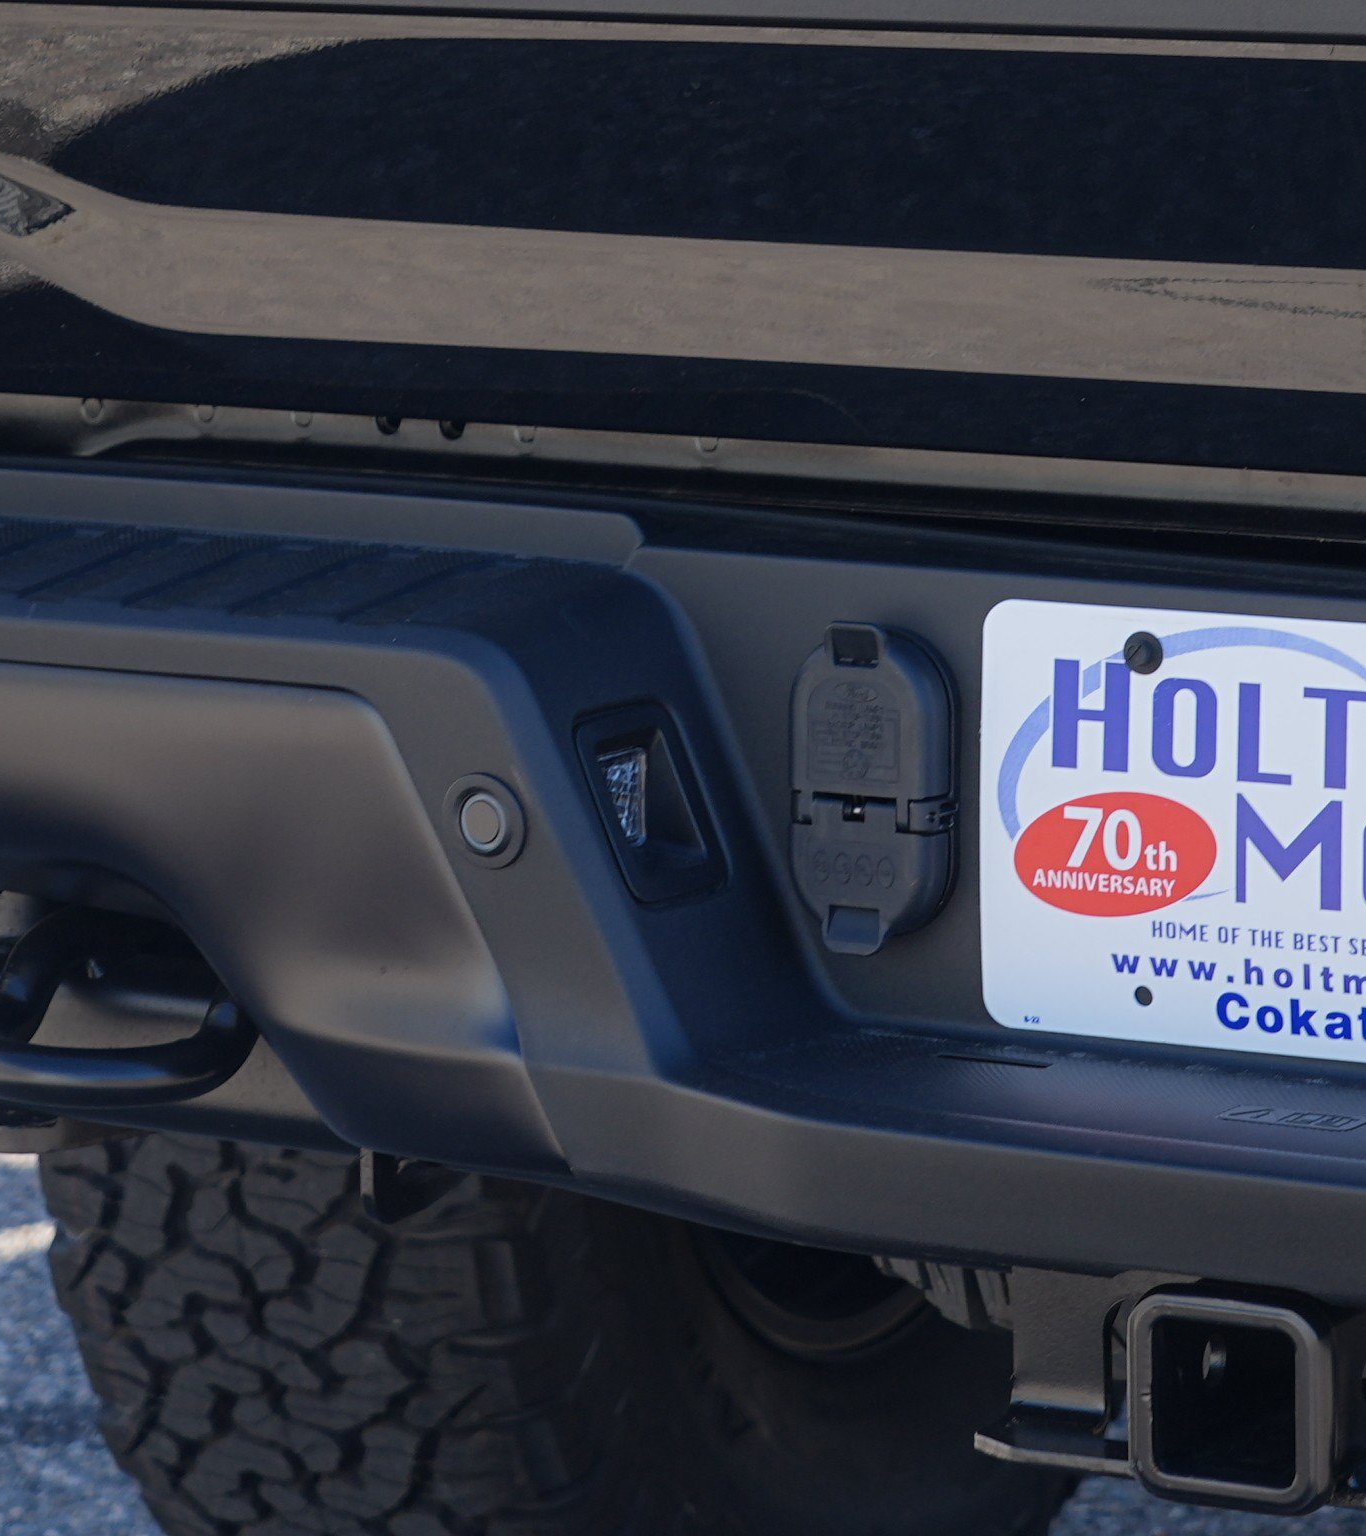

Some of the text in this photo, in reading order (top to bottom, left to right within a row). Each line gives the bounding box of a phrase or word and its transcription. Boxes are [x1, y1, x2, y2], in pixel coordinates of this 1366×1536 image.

[1063, 805, 1178, 873] 70th
[1033, 867, 1176, 899] ANNIVERSARY
[1151, 920, 1209, 943] HOME
[1218, 925, 1241, 945] OF
[1248, 928, 1285, 949] THE
[1293, 933, 1341, 954] BEST
